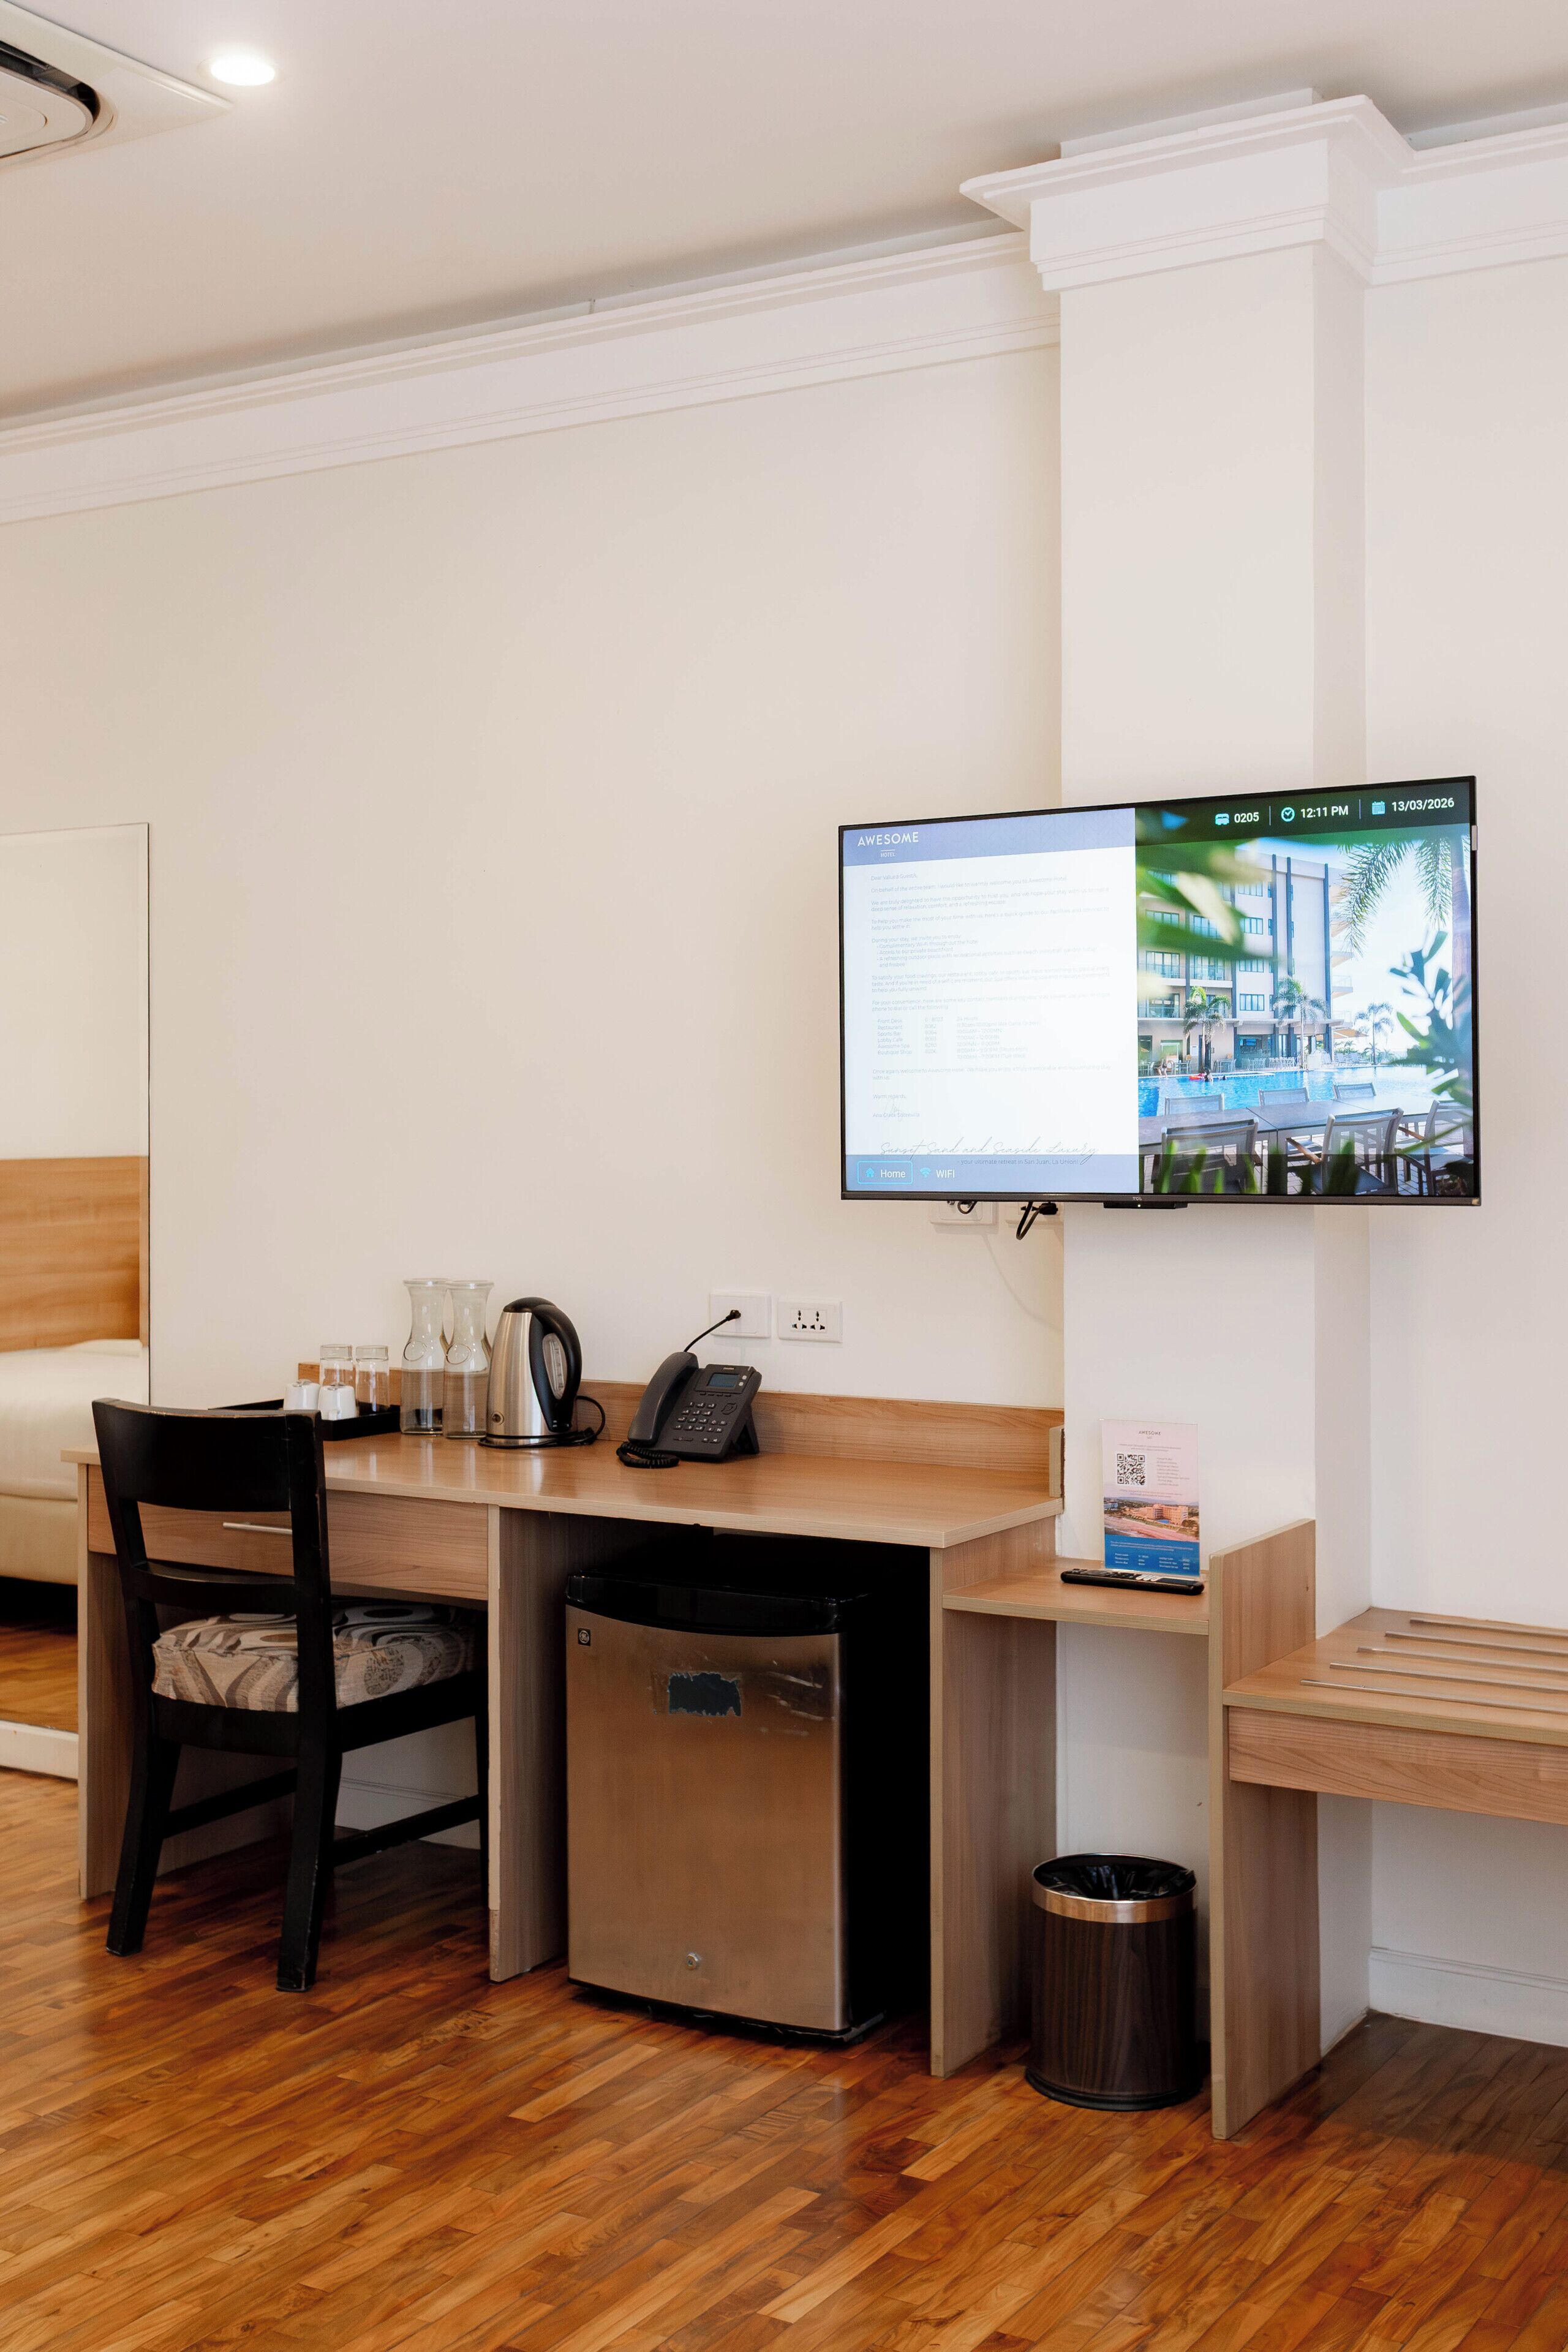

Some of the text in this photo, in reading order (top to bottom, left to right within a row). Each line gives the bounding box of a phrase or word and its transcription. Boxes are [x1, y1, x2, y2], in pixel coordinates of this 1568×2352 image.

[1392, 797, 1455, 812] 13/03/2026
[1234, 812, 1259, 823] 0205
[1301, 805, 1349, 818] 12:11 PM
[858, 832, 919, 846] AWESOME
[927, 1137, 963, 1155] Sand
[962, 1137, 993, 1153] and
[993, 1136, 1041, 1155] Seaside
[1046, 1142, 1098, 1164] Luxury
[880, 1169, 906, 1178] Home
